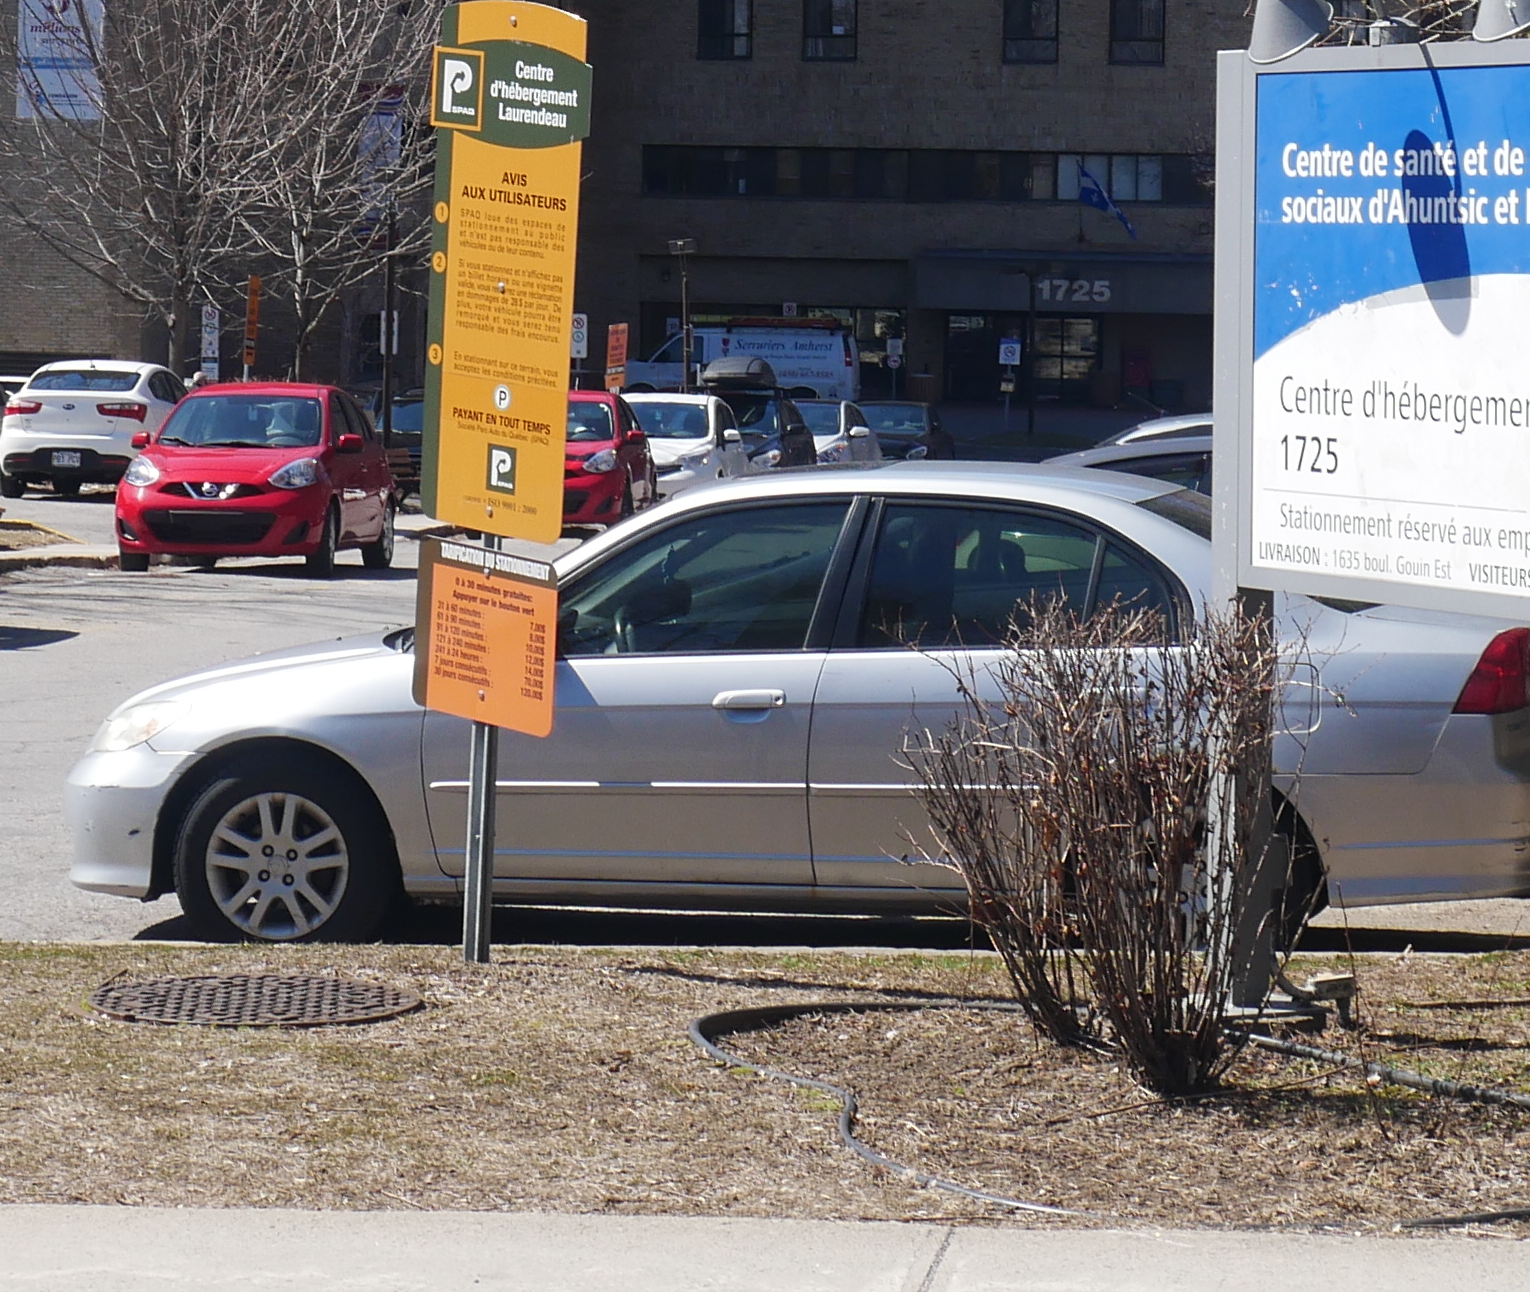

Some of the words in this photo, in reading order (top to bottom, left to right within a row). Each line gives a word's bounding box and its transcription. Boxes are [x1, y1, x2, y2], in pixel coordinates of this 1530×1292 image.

[516, 61, 554, 82] Centre
[490, 80, 577, 107] d'hébergement
[499, 103, 567, 128] Laurendeau
[1282, 142, 1353, 178] Centre
[1359, 142, 1388, 177] de
[1393, 140, 1456, 176] santé
[1464, 141, 1488, 176] et
[1494, 139, 1524, 176] de
[502, 172, 527, 186] AVIS
[462, 186, 485, 200] AUX
[490, 189, 567, 211] UTILISATEURS
[1282, 189, 1363, 224] sociaux
[1369, 188, 1488, 224] d'Ahuntsic
[1494, 189, 1519, 224] et
[460, 220, 519, 235] stationnement
[540, 231, 565, 242] public
[505, 215, 517, 225] des
[557, 222, 565, 232] de
[490, 234, 502, 243] pas
[505, 235, 548, 250] responsable
[553, 242, 564, 252] des
[437, 256, 442, 267] 2
[467, 262, 480, 270] vous
[537, 281, 562, 293] vignette
[1037, 280, 1111, 302] 1725
[456, 320, 494, 333] responsable
[497, 325, 508, 335] des
[511, 327, 525, 338] frais
[503, 318, 519, 327] vous
[433, 349, 437, 359] 3
[454, 351, 462, 360] En
[464, 354, 497, 367] stationnant
[499, 360, 509, 368] sur
[544, 369, 558, 377] vous
[454, 363, 480, 375] acceptez
[482, 367, 490, 376] les
[493, 369, 525, 382] conditions
[499, 391, 507, 406] P
[1280, 376, 1353, 416] Centre
[453, 407, 483, 422] PAYANT
[486, 414, 496, 425] EN
[499, 415, 520, 429] TOUT
[523, 419, 551, 435] TEMPS
[1281, 435, 1338, 474] 1725
[1280, 503, 1392, 538] Stationnement
[1398, 513, 1457, 544] réservé
[1463, 525, 1492, 548] aux
[1259, 541, 1320, 565] LIVRAISON
[1333, 550, 1360, 570] 1635
[1364, 552, 1392, 574] boul.
[1396, 555, 1430, 578] Gouin
[1435, 559, 1451, 580] Est
[476, 582, 500, 595] minutes
[453, 590, 478, 604] Appuyer
[522, 606, 534, 617] vert
